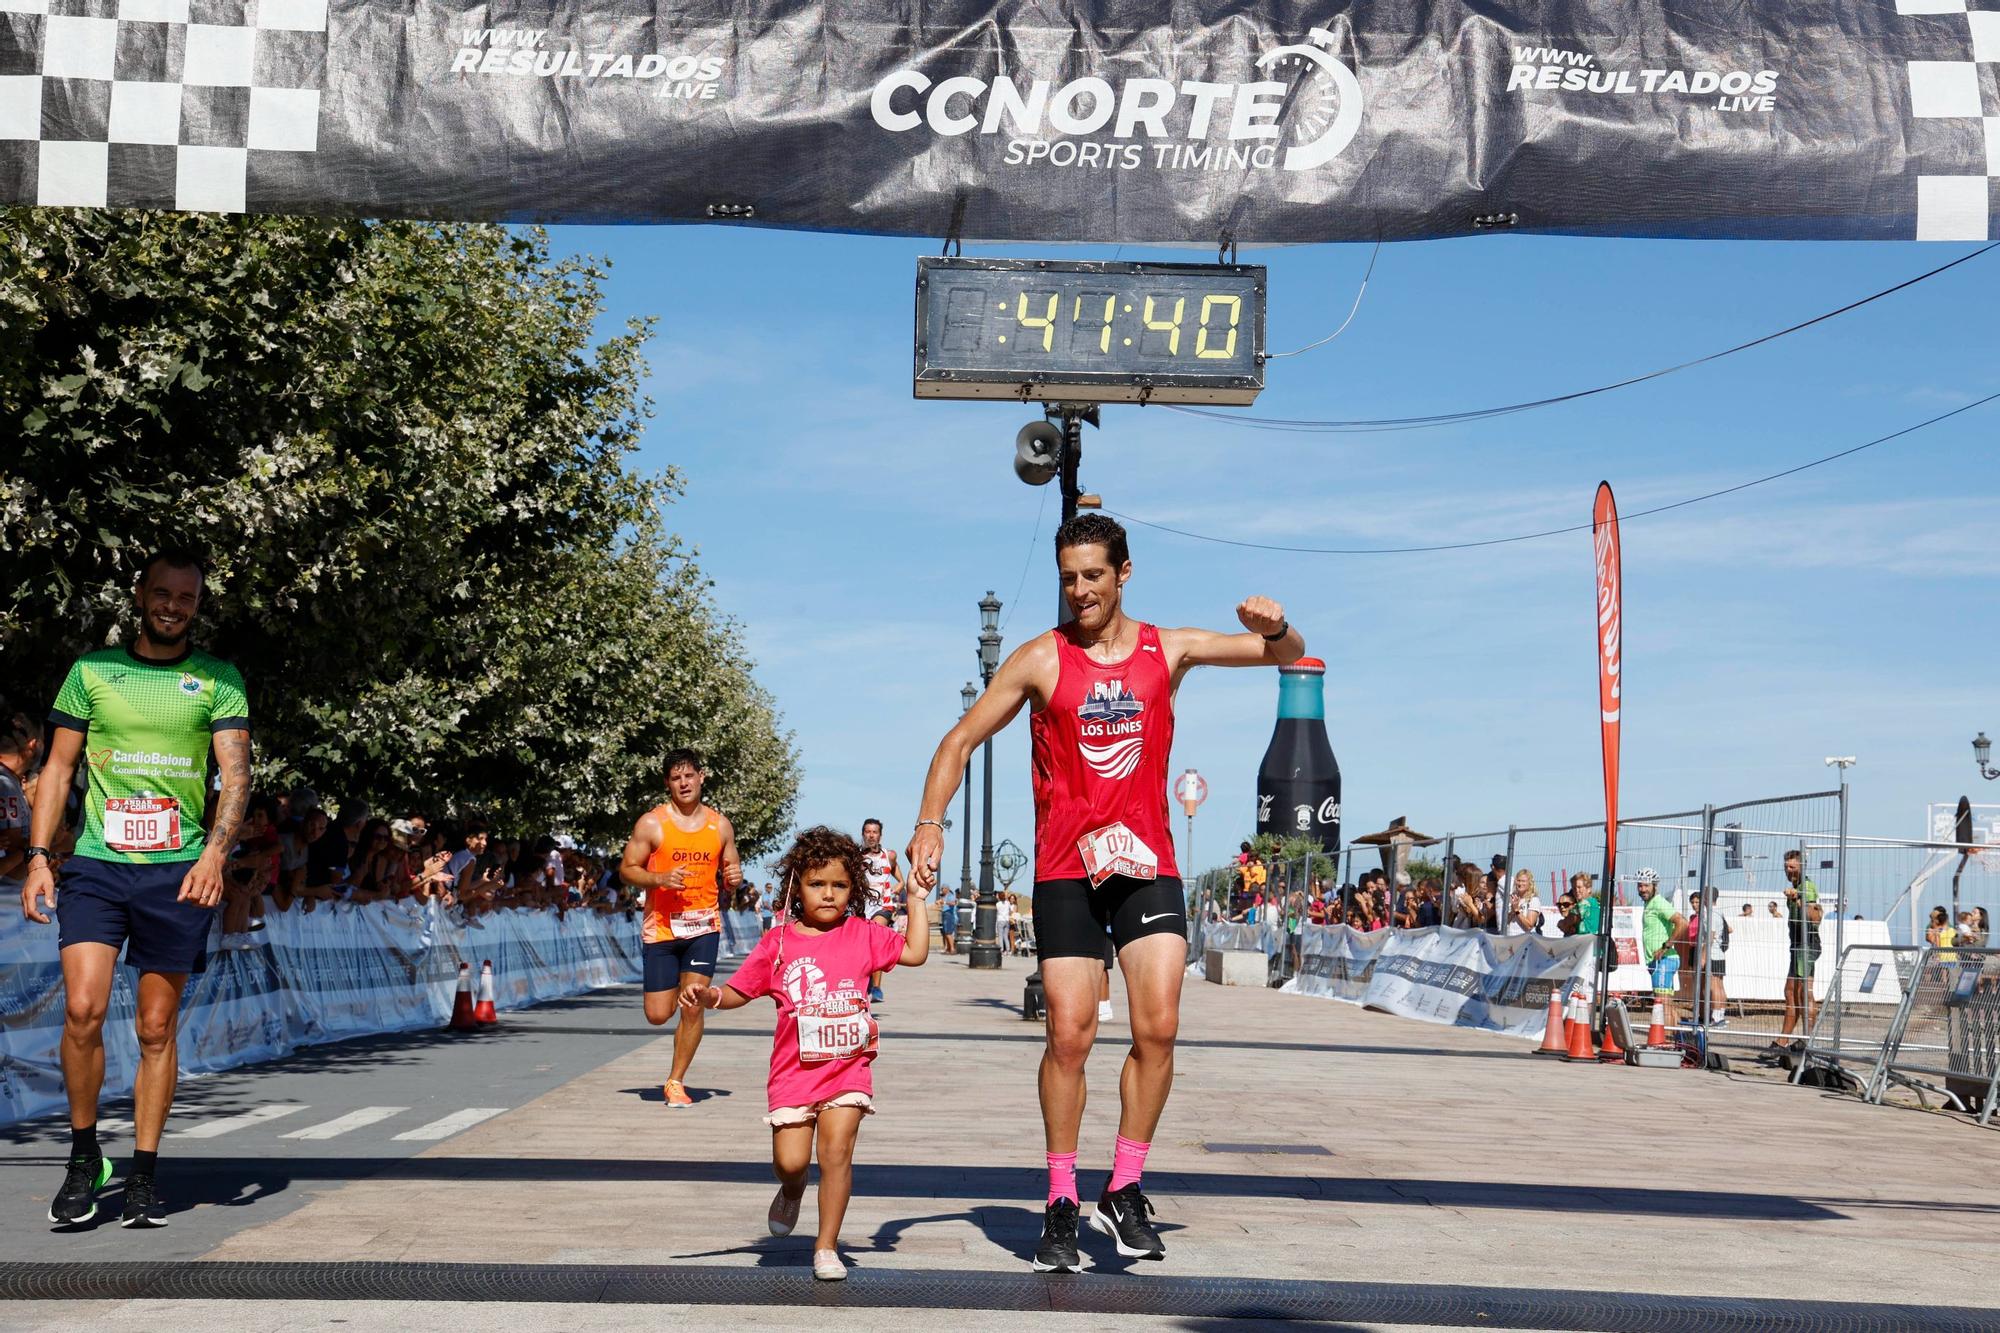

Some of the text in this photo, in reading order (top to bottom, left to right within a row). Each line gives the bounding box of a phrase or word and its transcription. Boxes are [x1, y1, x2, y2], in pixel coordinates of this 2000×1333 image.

[451, 47, 726, 81] RESULTADOS
[1506, 65, 1779, 95] RESULTADOS
[870, 69, 1287, 140] CCNORTE
[1003, 140, 1275, 170] SPORTS TIMING
[1081, 720, 1142, 736] LOS LUNES
[113, 750, 192, 766] CardioBaiona
[151, 767, 161, 777] de
[125, 820, 157, 841] 609
[818, 1022, 860, 1048] 1058
